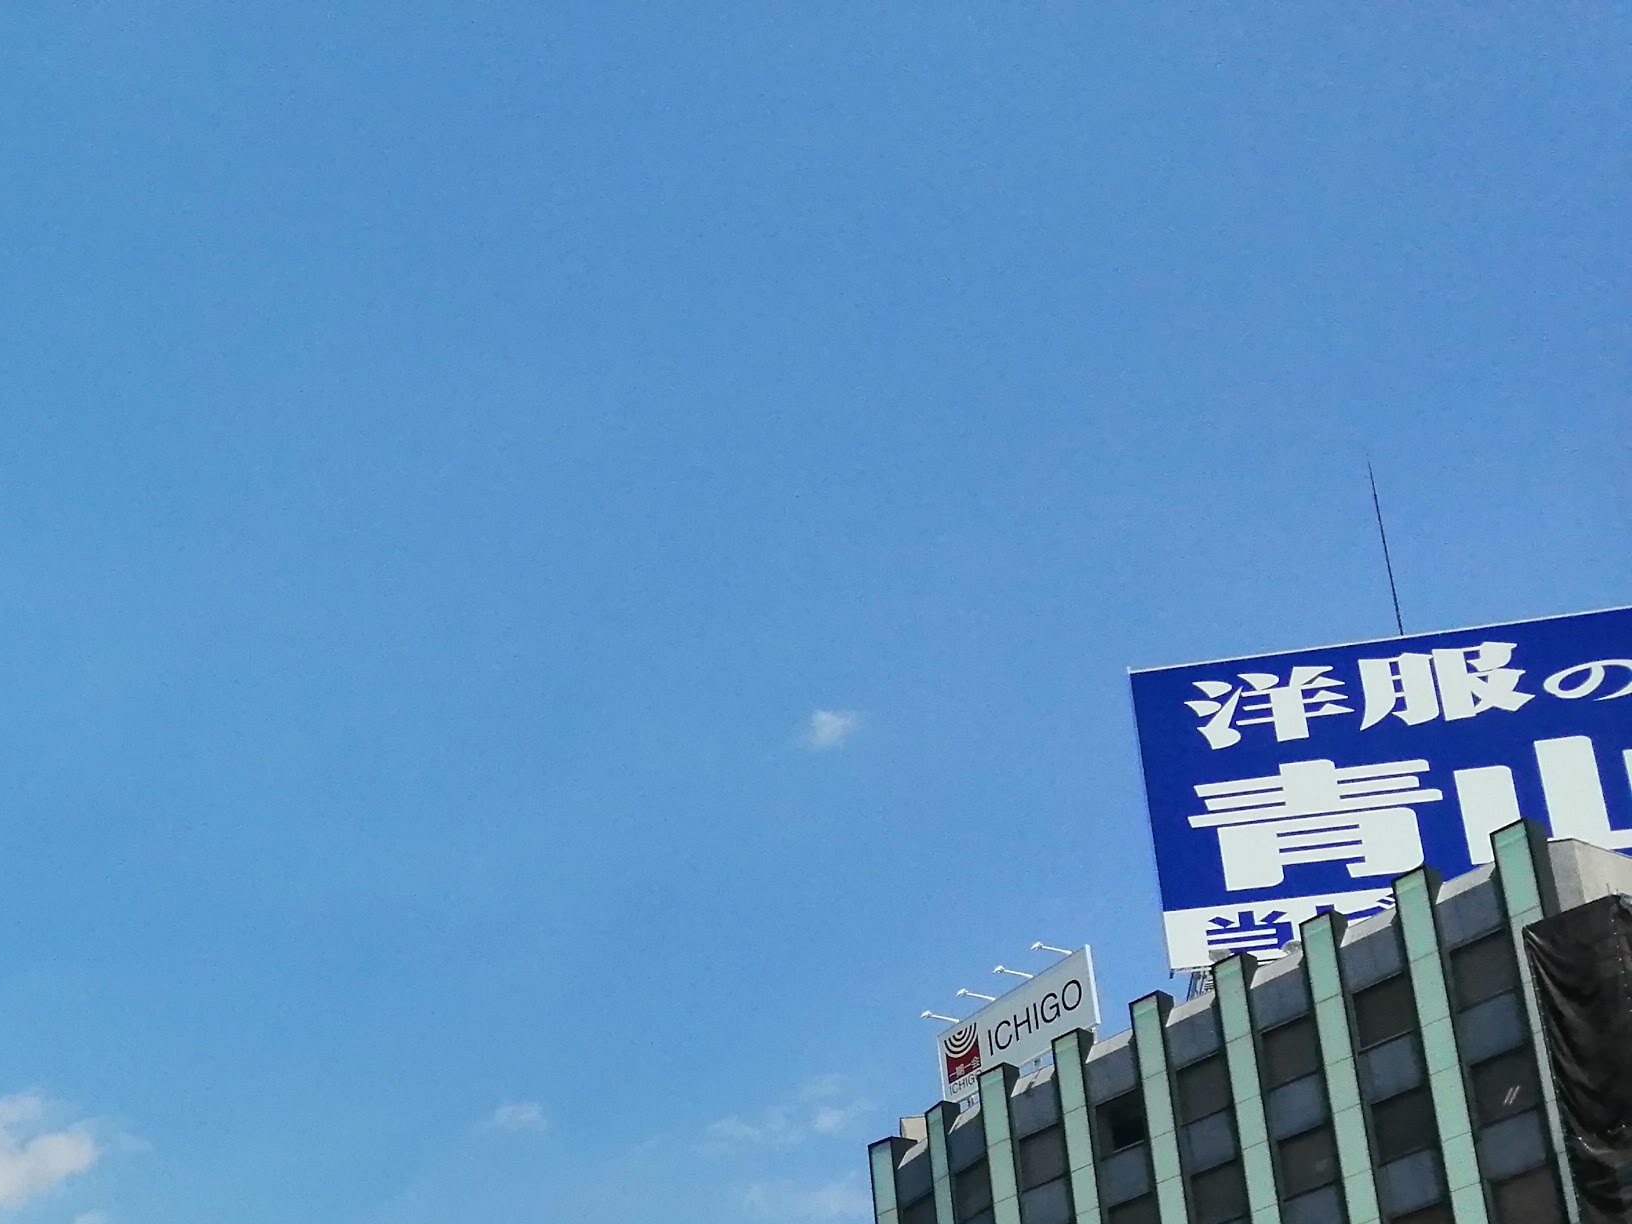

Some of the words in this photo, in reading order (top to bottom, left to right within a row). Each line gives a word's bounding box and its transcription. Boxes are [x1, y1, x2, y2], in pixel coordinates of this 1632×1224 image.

[1184, 641, 1632, 750] 洋服の
[1187, 735, 1632, 891] 青山
[987, 979, 1082, 1056] ICHIGO
